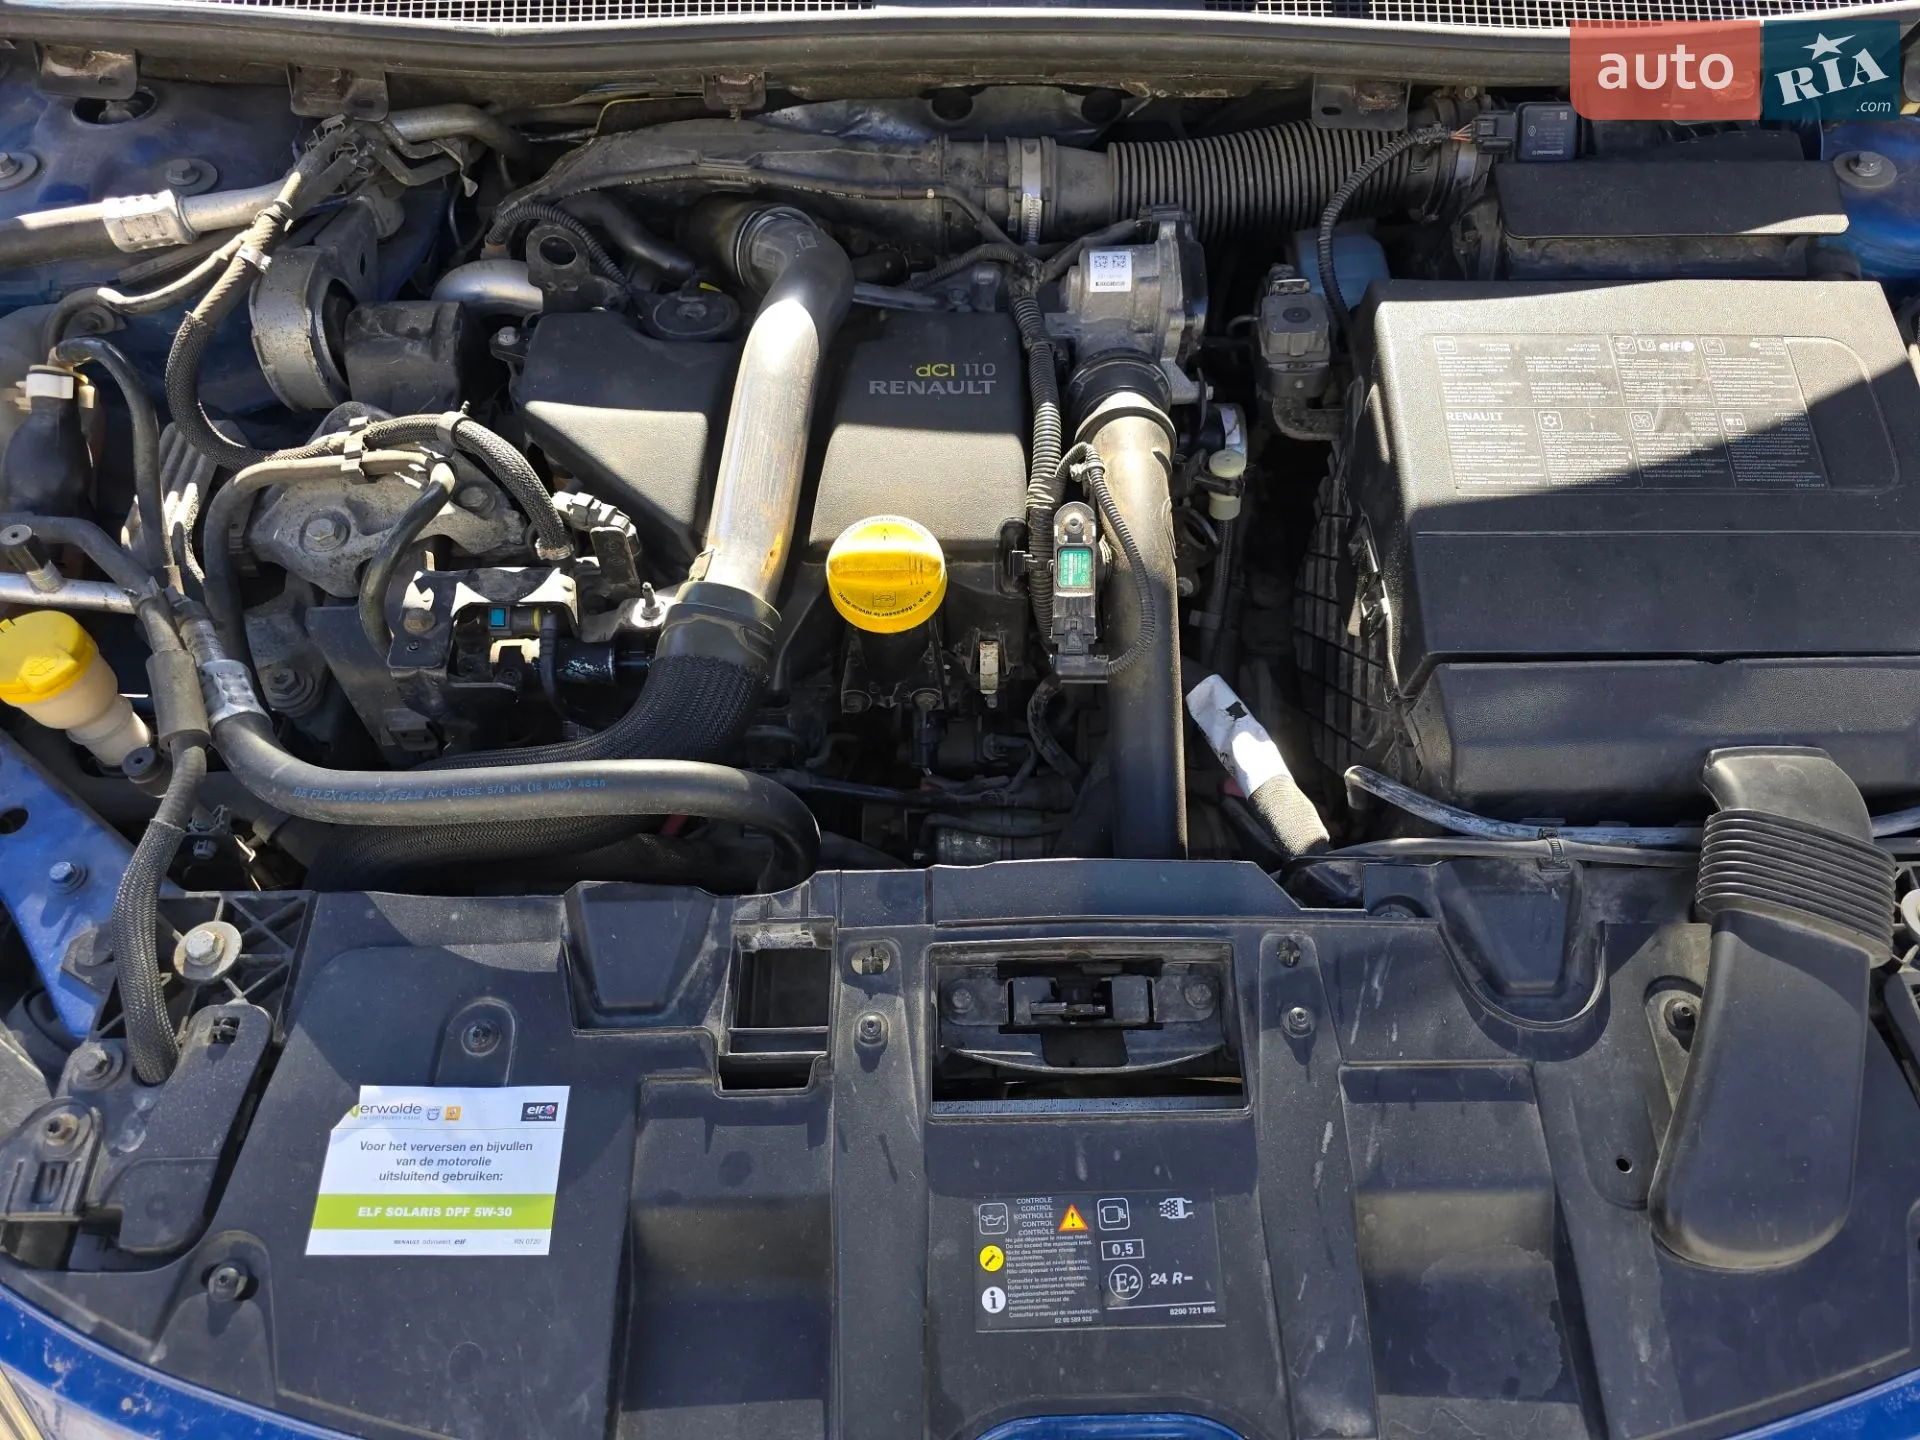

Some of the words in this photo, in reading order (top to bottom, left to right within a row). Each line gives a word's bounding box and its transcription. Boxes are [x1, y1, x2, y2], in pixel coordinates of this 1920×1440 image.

[963, 363, 996, 377] 110
[869, 380, 996, 395] RENAULT
[1446, 411, 1503, 421] RENAULT
[310, 788, 337, 801] FLEX
[428, 788, 447, 798] A/C
[452, 787, 481, 797] HOSE
[510, 785, 521, 793] IN
[549, 779, 571, 790] MM)
[527, 1105, 546, 1114] elf
[360, 1141, 387, 1152] Voor
[389, 1141, 408, 1152] het
[410, 1143, 467, 1152] verversen
[469, 1144, 483, 1152] en
[486, 1141, 533, 1155] bijvullen
[396, 1158, 417, 1167] van
[419, 1156, 434, 1166] de
[436, 1157, 492, 1167] motorolie
[378, 1171, 439, 1181] uitsluitend
[442, 1171, 504, 1183] gebruiken:
[1016, 1197, 1053, 1205] CONTROLE
[357, 1207, 382, 1217] ELF
[385, 1207, 441, 1217] SOLARIS
[445, 1207, 471, 1217] DPF
[474, 1207, 513, 1217] 5W-30
[1022, 1220, 1054, 1228] CONTROL
[1111, 1242, 1134, 1257] 0,5
[1114, 1273, 1139, 1293] E2
[1150, 1272, 1168, 1285] 24
[1188, 1307, 1201, 1315] 721
